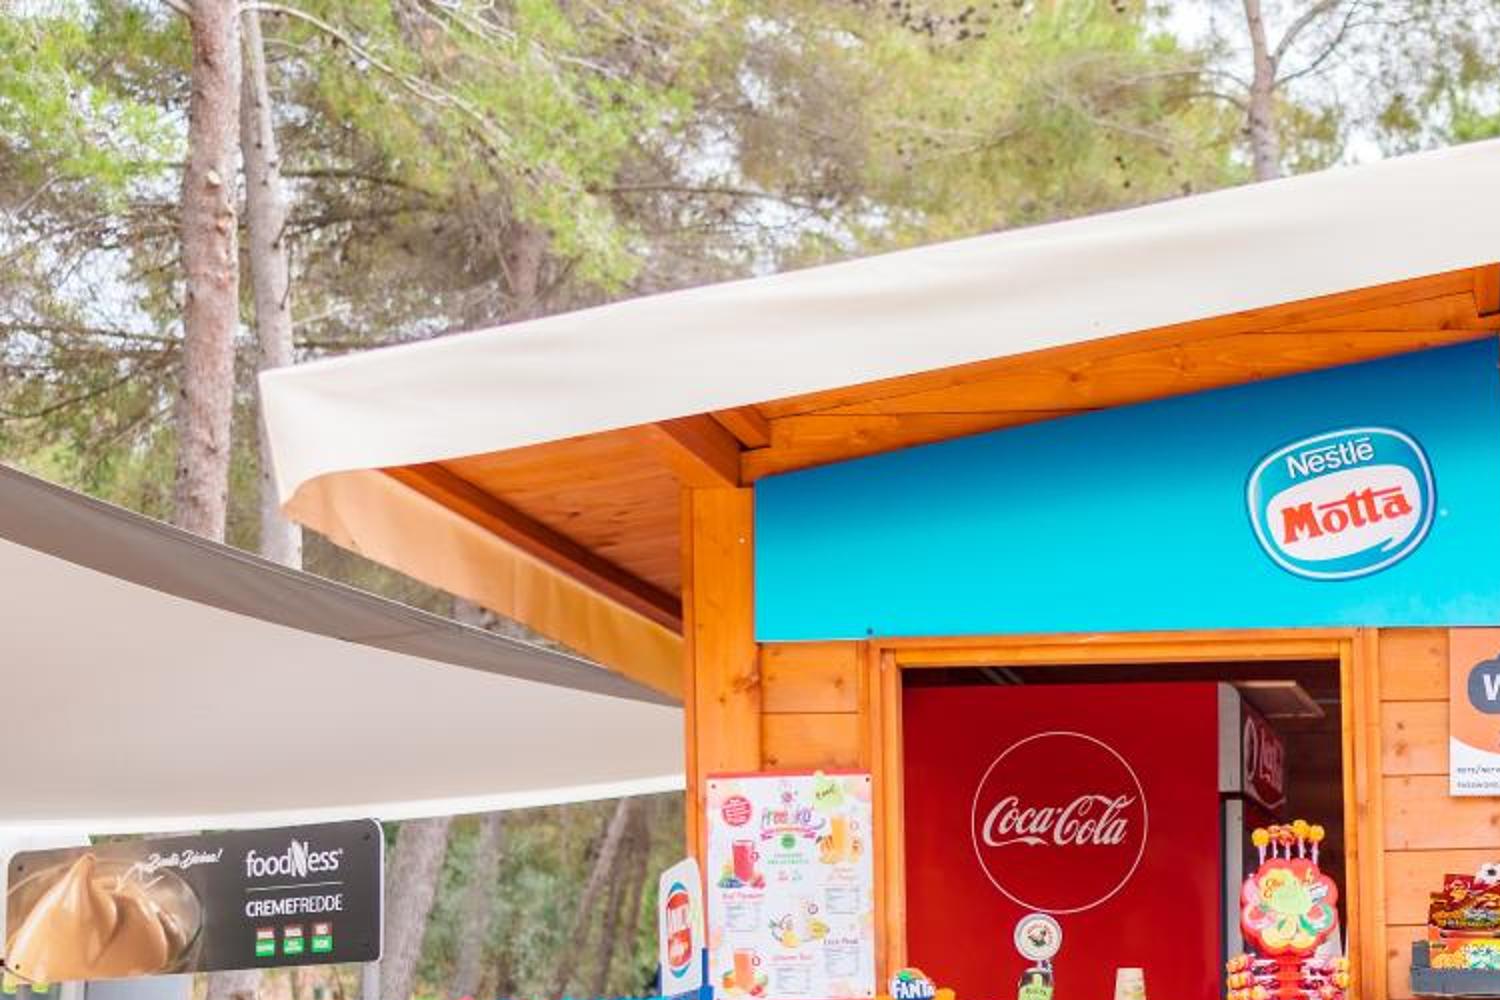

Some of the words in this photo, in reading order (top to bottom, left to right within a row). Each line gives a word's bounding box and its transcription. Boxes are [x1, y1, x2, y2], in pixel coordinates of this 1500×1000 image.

[1286, 437, 1374, 479] Nestlé
[1280, 487, 1413, 545] Motta
[982, 795, 1137, 848] Coca-Cola
[246, 894, 344, 917] CREMEFREDDE
